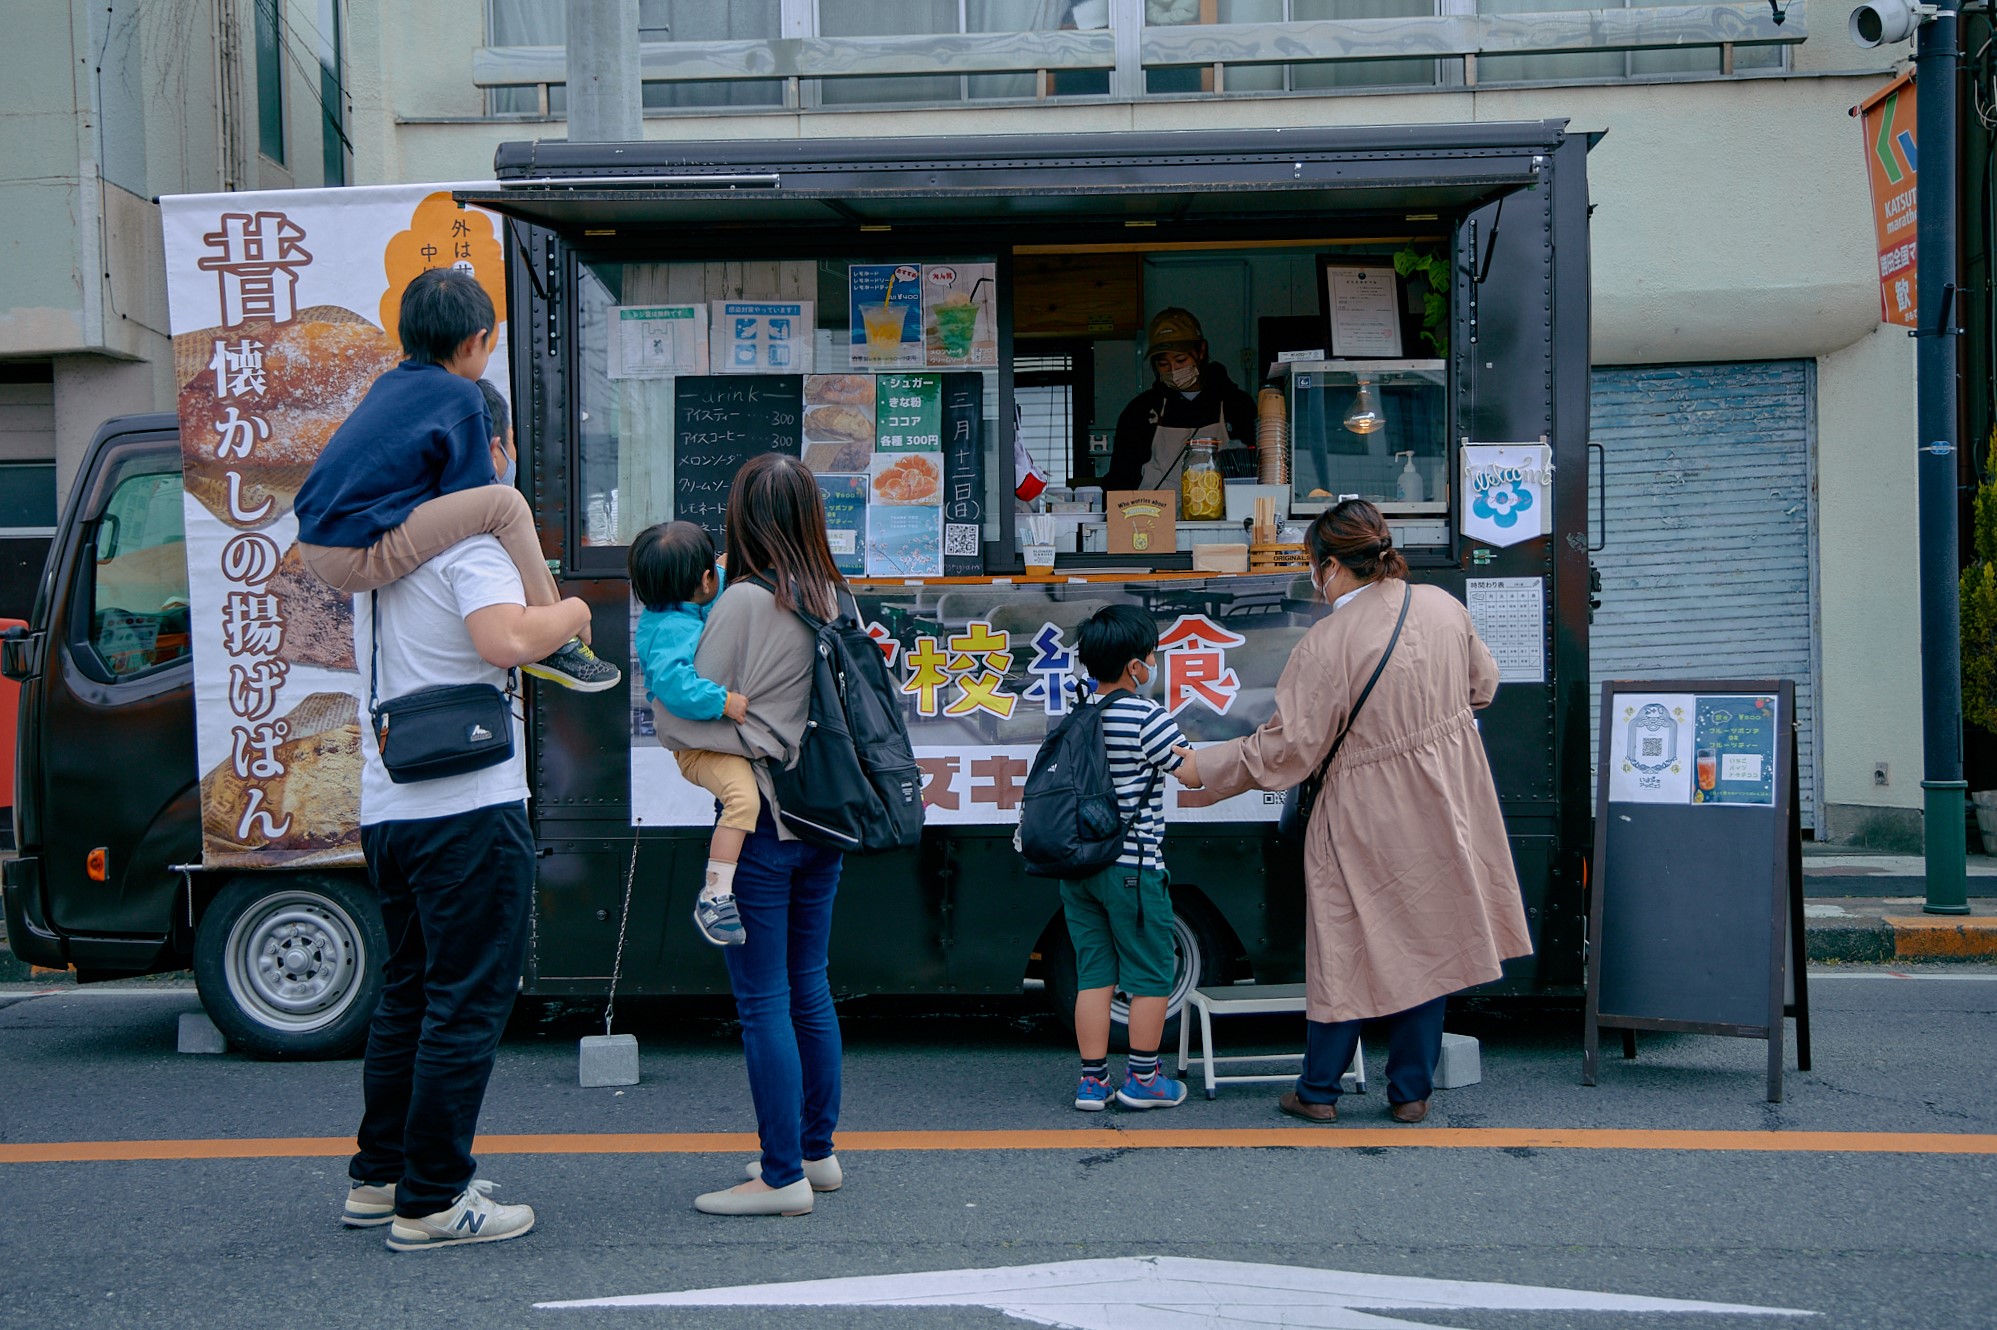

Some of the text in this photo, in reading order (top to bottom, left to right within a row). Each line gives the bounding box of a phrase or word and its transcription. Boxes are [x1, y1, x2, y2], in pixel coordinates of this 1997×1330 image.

[1884, 187, 1917, 219] KATSUT
[1880, 242, 1917, 277] 勝田全国マ
[889, 377, 934, 390] シュガー
[888, 397, 922, 408] きな粉
[682, 407, 795, 426] アイスティー 300
[888, 416, 922, 427] ココア
[680, 430, 793, 449] アイスコーヒー 300
[880, 435, 939, 447] 各種 300円
[678, 453, 743, 467] メロンソーダ
[678, 478, 733, 493] クリームソー
[198, 210, 313, 845] 昔懐かしの揚げぱん
